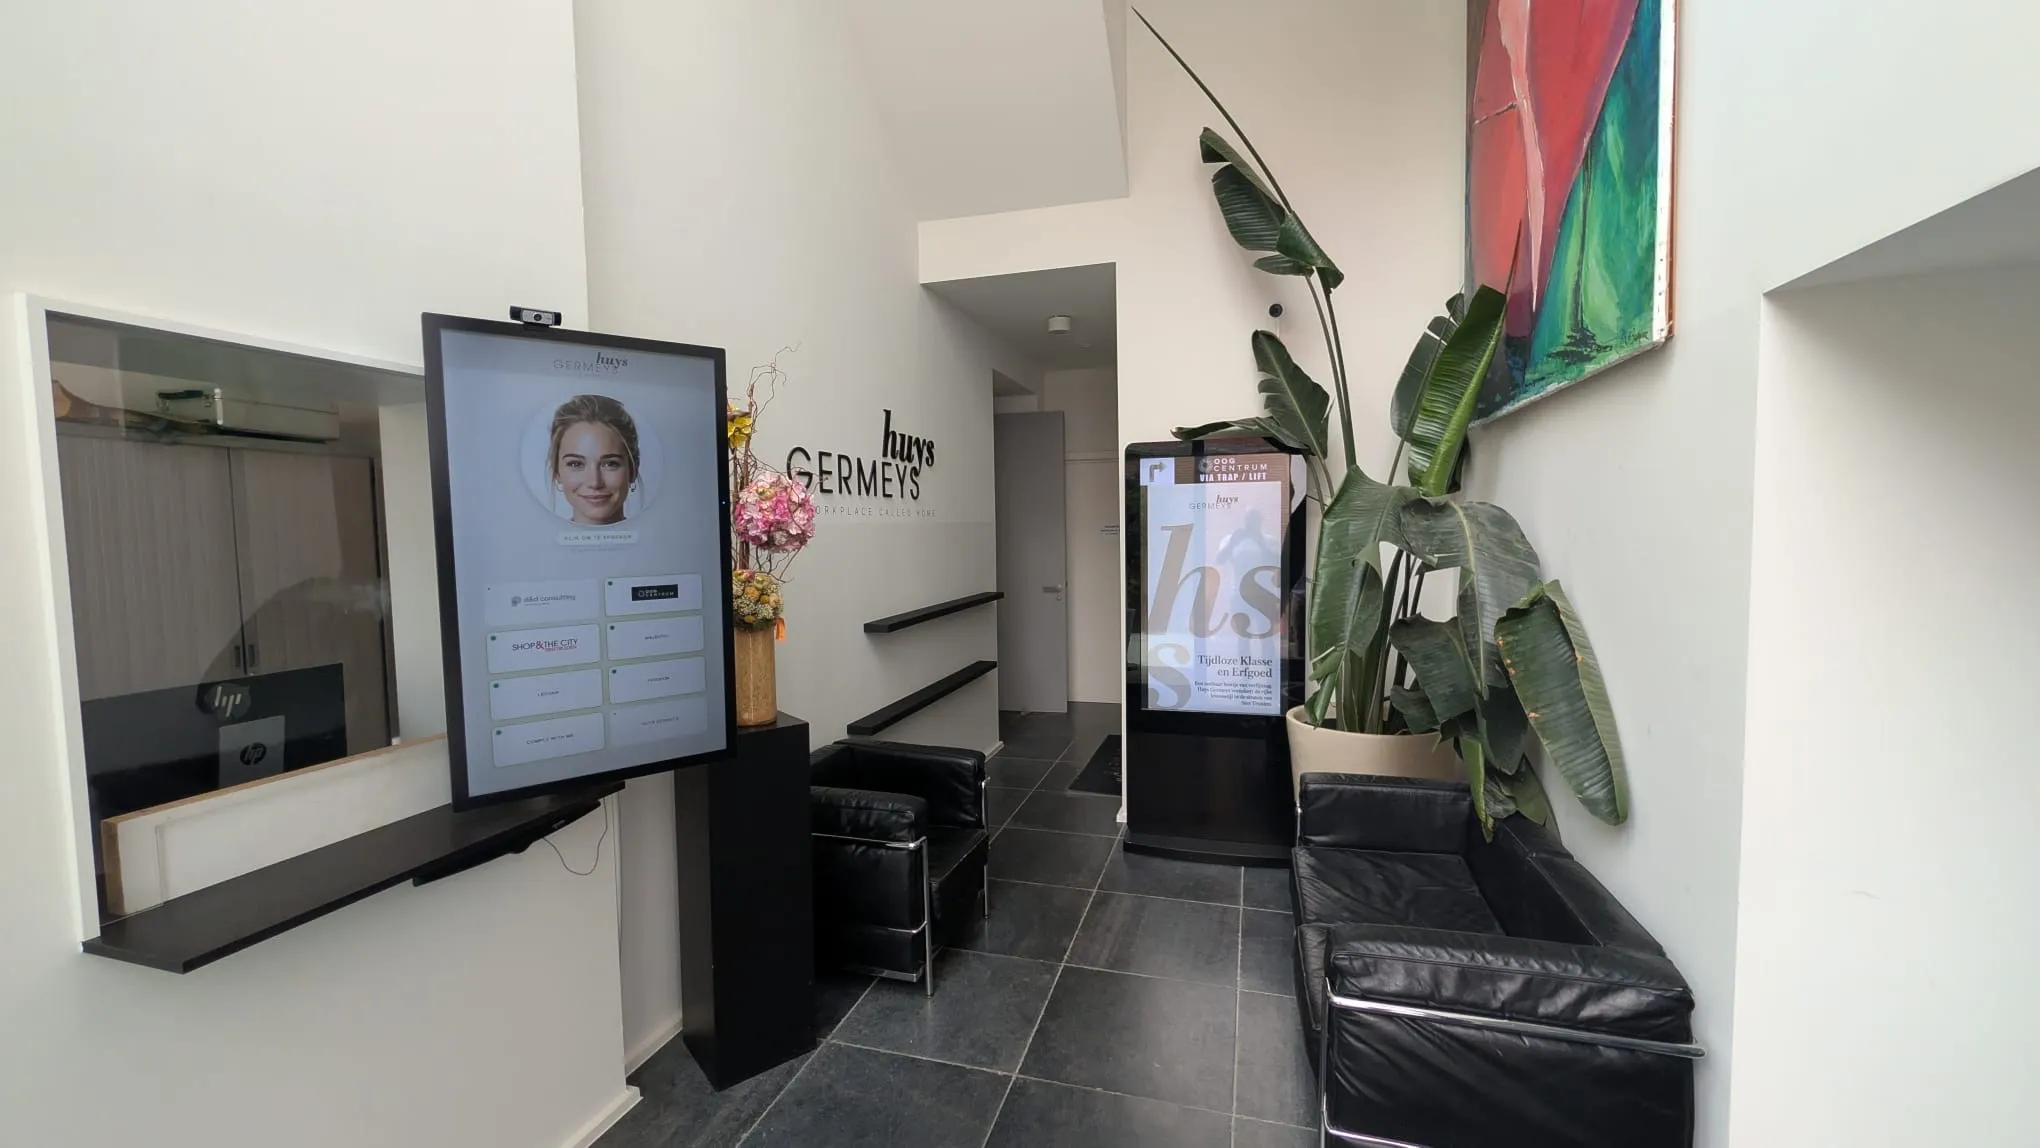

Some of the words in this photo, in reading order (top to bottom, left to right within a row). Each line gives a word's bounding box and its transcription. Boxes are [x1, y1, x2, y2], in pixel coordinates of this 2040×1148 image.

[596, 351, 628, 369] huys
[553, 359, 619, 374] GERMEYS
[882, 409, 935, 476] huys
[1213, 457, 1236, 465] OOG
[786, 446, 920, 500] GERMEYS
[1213, 464, 1268, 472] CENTRUM
[1200, 473, 1214, 482] VIA
[1217, 474, 1239, 482] TRAP
[1249, 472, 1267, 481] LIFT
[1216, 494, 1239, 505] huys
[815, 505, 873, 516] ORKPLACE
[1189, 502, 1232, 510] GERMEYS
[560, 638, 578, 648] CITY
[1198, 655, 1238, 667] Tijdloze
[1240, 655, 1273, 666] Klasse
[1217, 668, 1229, 677] en
[1232, 667, 1273, 679] Erfgoed
[214, 685, 242, 717] hp
[241, 743, 266, 766] hp
